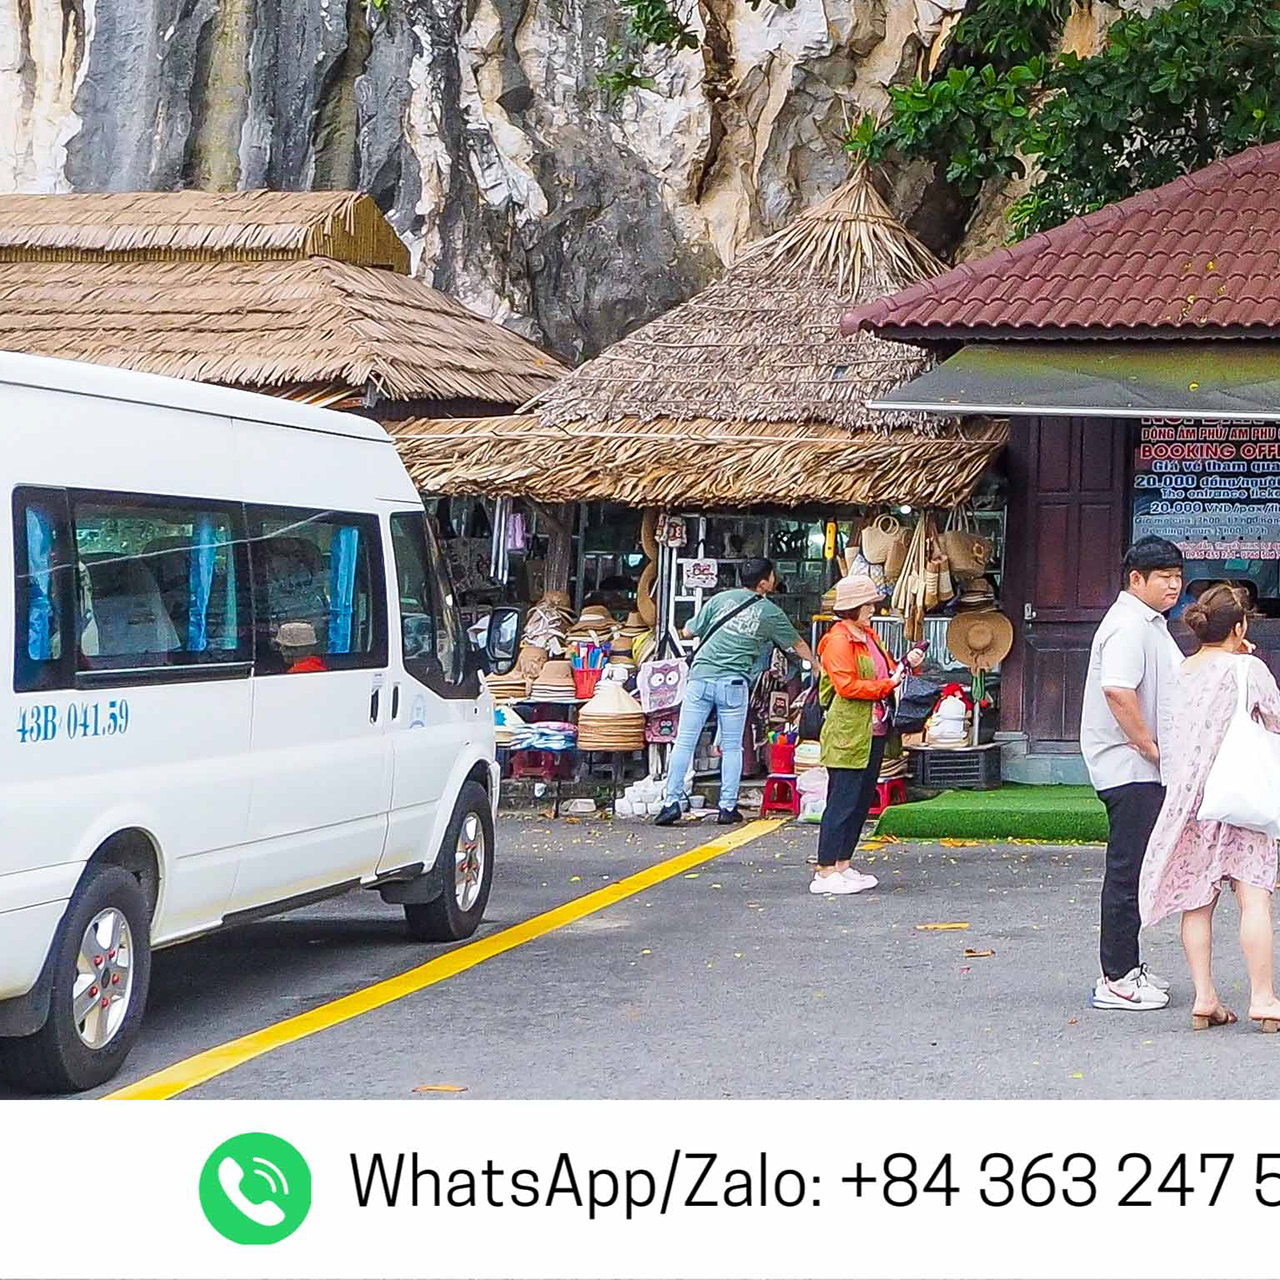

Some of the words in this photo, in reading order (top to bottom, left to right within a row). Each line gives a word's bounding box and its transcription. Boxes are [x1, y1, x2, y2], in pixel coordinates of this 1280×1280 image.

[1177, 425, 1197, 440] ÂM
[1229, 427, 1248, 440] AM
[1252, 427, 1276, 440] PHU
[1140, 443, 1236, 460] BOOKING
[1206, 461, 1247, 472] tham
[1134, 474, 1197, 488] 20.000
[1160, 488, 1185, 499] The
[1187, 488, 1247, 499] entrance
[1150, 502, 1203, 514] 20.000
[17, 704, 57, 743] 43B
[67, 699, 129, 740] 041.59
